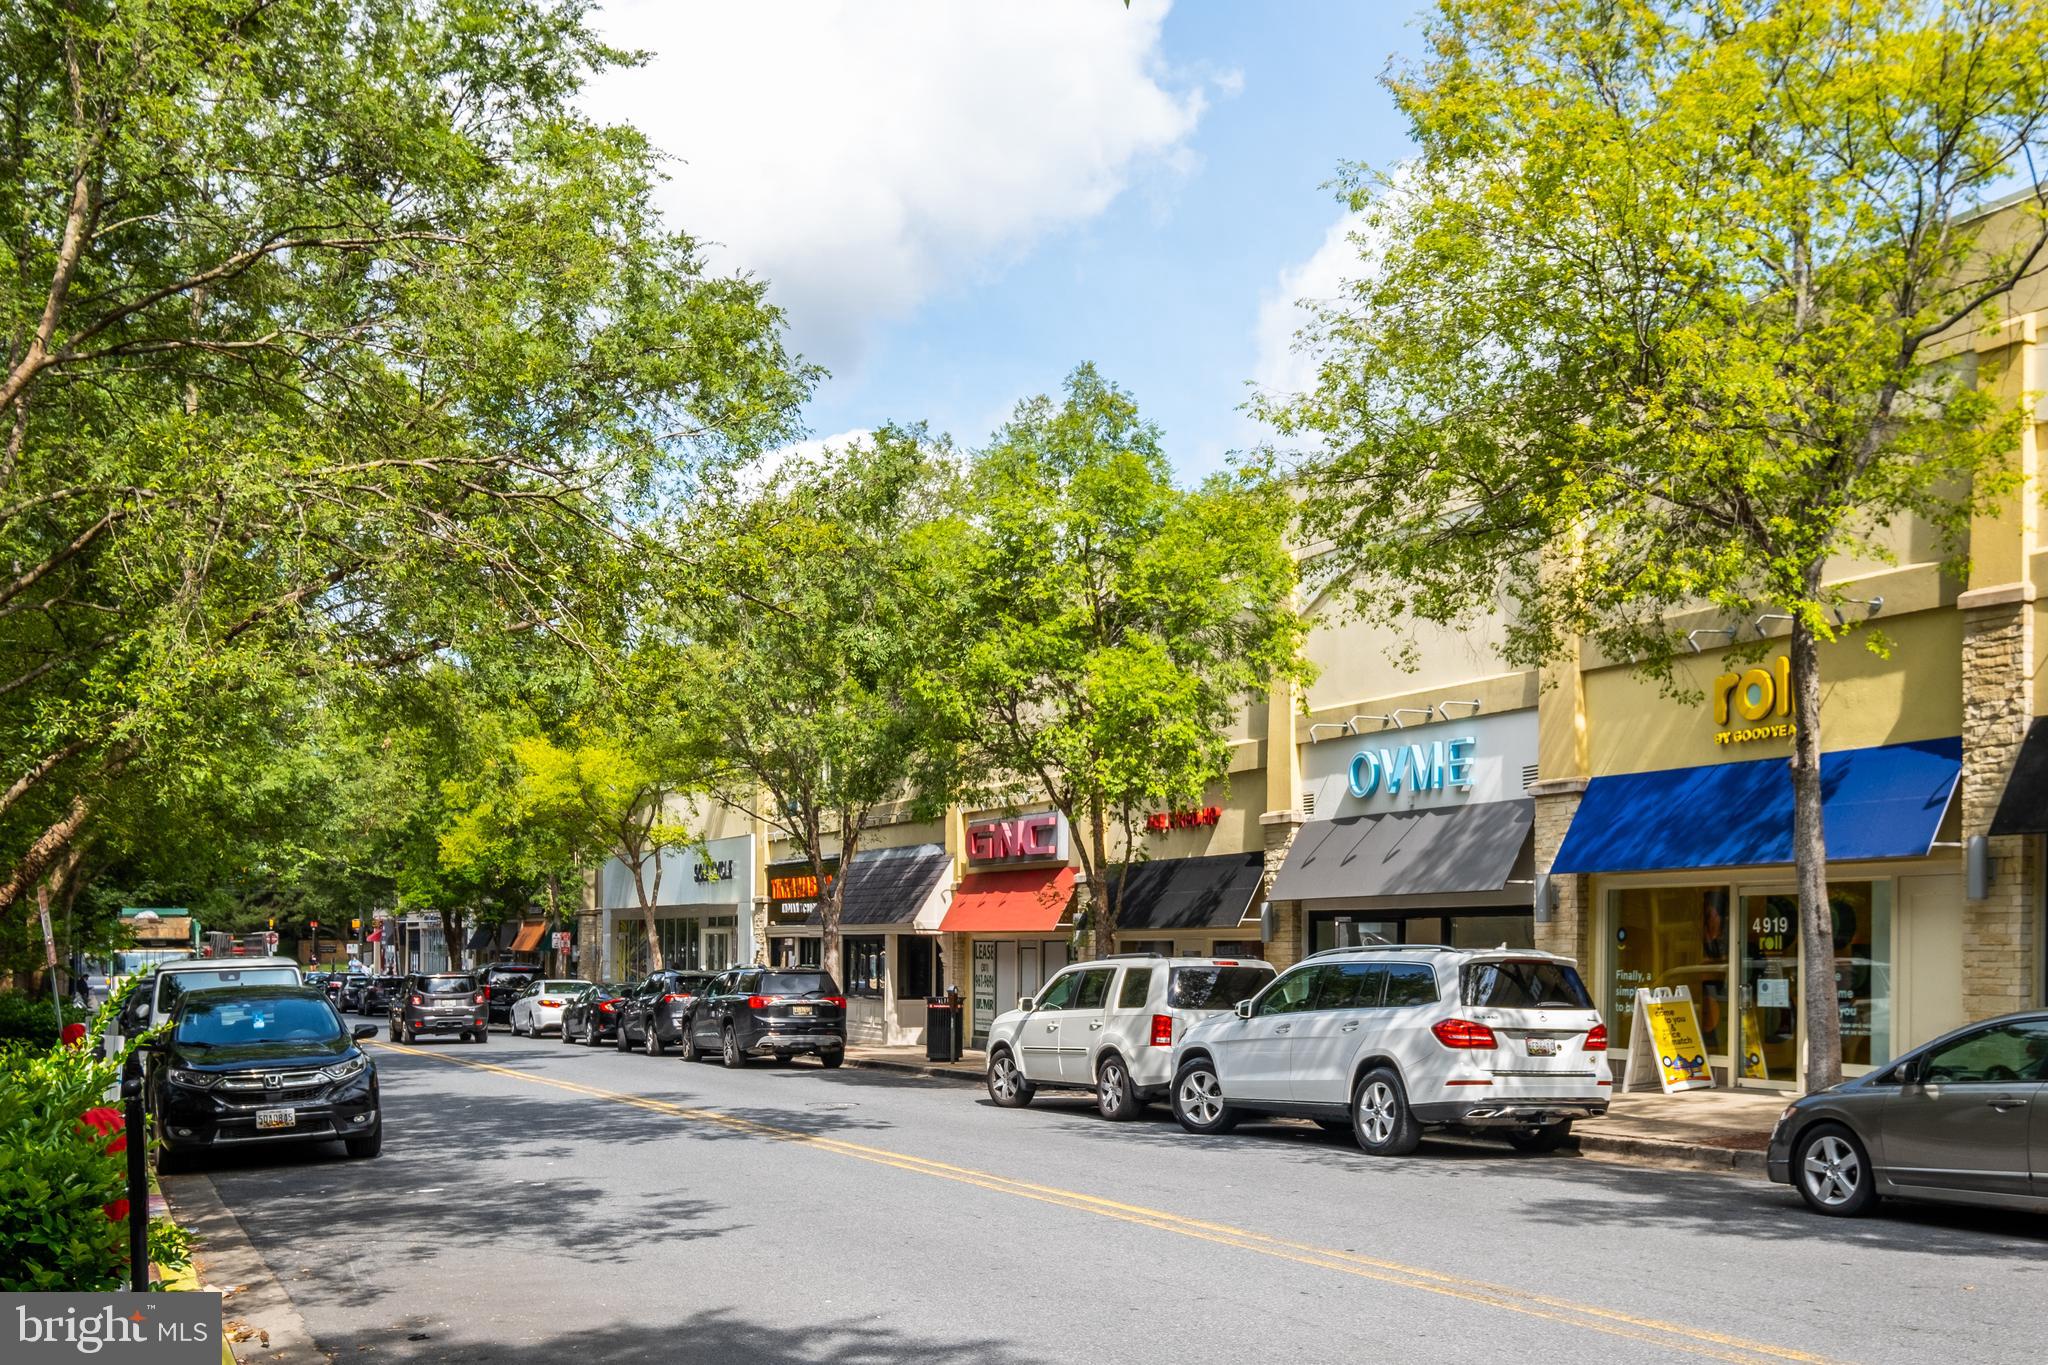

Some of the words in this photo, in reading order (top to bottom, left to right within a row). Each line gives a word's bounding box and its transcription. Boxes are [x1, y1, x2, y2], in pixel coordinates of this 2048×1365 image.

[1713, 655, 1795, 727] rol
[1714, 731, 1731, 744] BY
[1733, 723, 1797, 742] GOODYEA
[1348, 736, 1476, 799] OVME
[965, 816, 1056, 859] GNC
[1752, 917, 1788, 933] 4919
[1759, 935, 1783, 950] roll
[975, 943, 994, 960] LEASE
[1615, 969, 1644, 983] Finally,
[1615, 1003, 1624, 1012] to
[1625, 1002, 1634, 1013] bu
